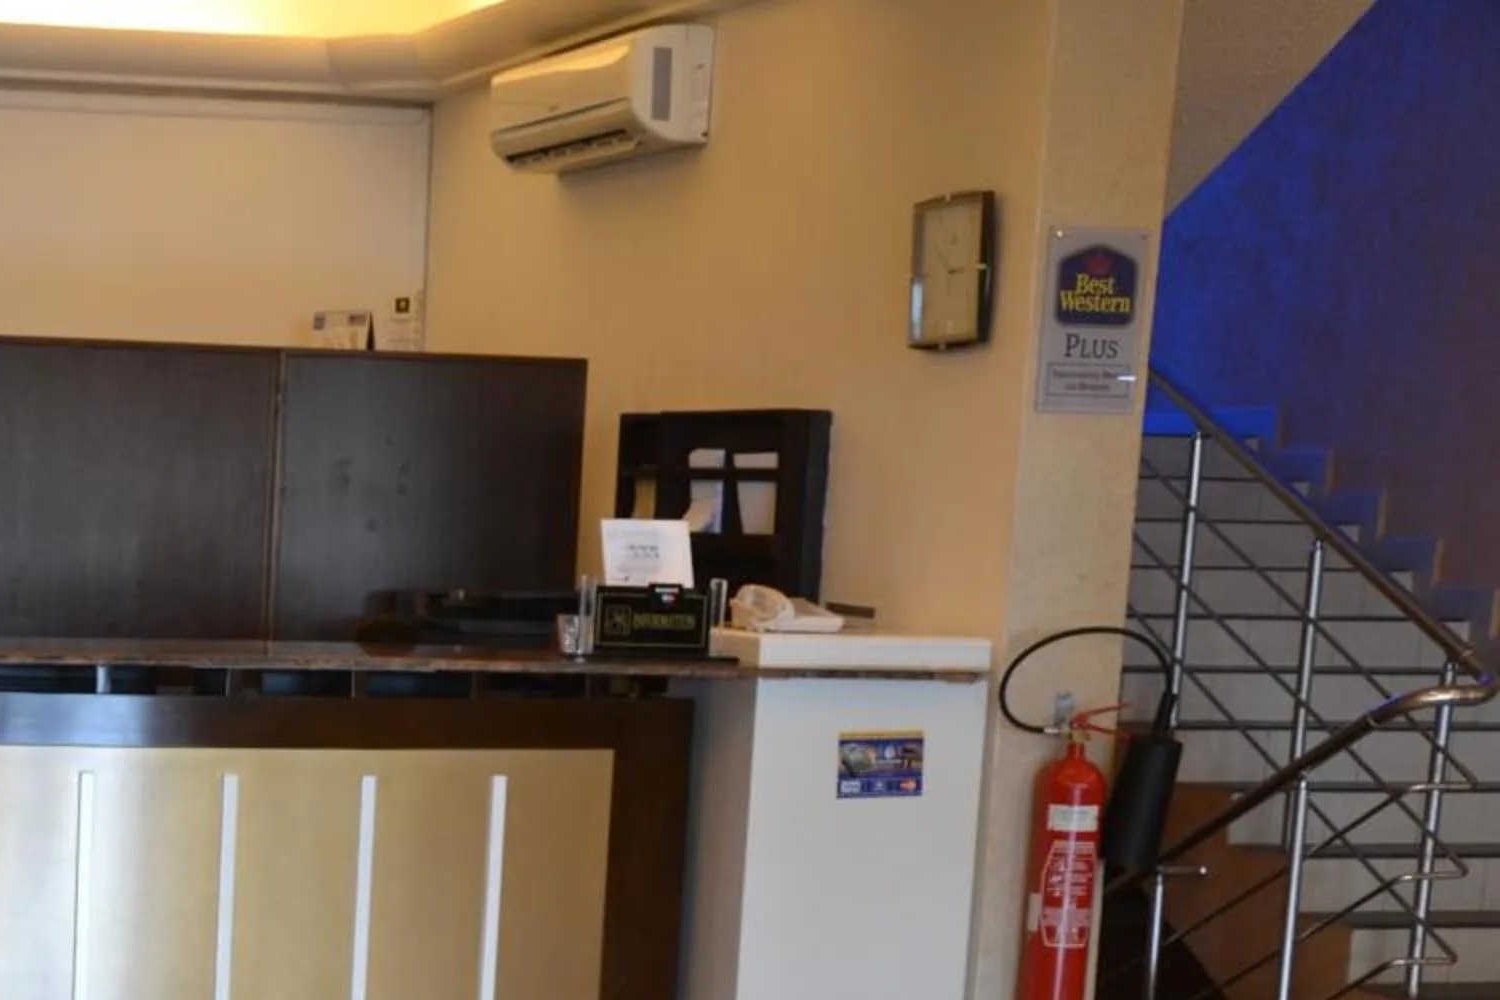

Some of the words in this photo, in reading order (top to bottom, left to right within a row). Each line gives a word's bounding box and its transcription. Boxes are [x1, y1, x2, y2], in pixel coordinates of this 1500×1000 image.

[1076, 273, 1115, 295] Best
[1060, 290, 1131, 313] Western
[1064, 333, 1119, 359] PLUS
